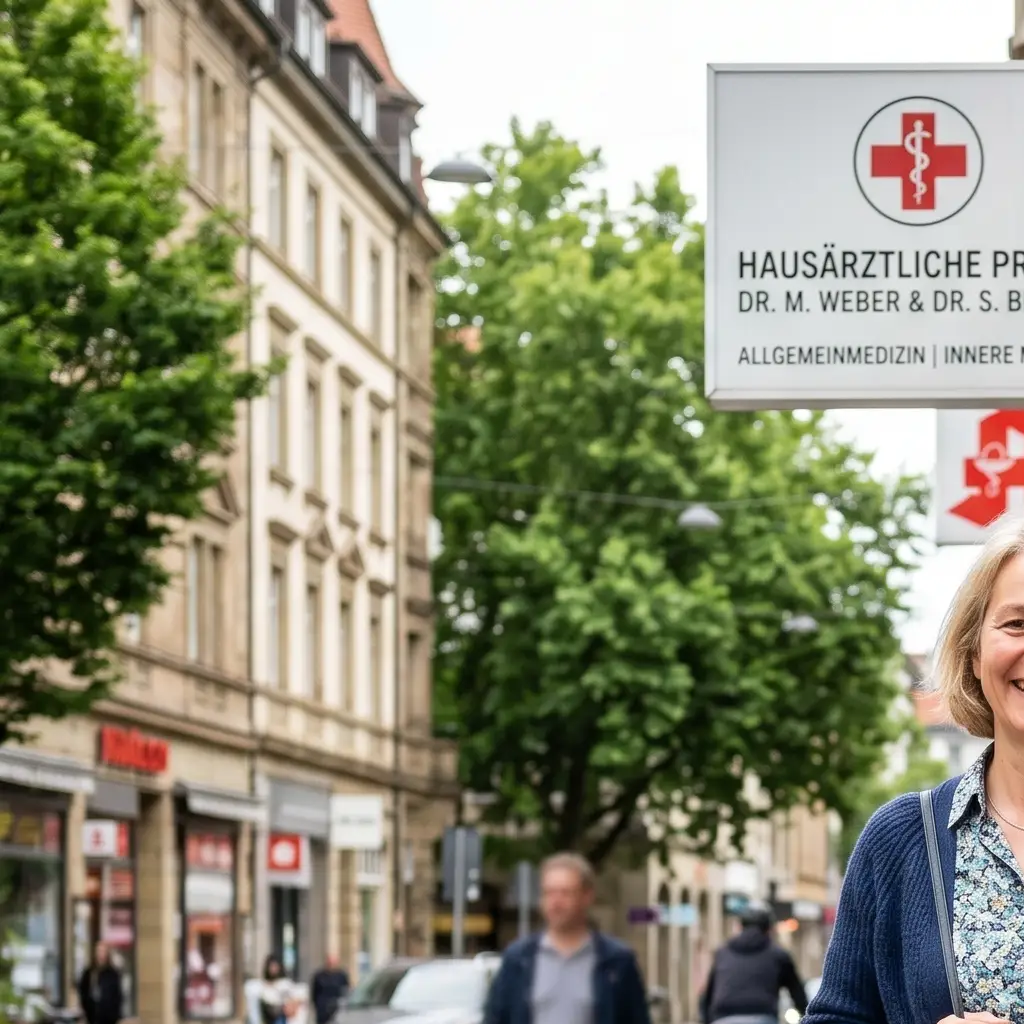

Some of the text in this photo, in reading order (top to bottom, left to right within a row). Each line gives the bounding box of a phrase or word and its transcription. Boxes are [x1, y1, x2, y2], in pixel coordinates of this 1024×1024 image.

[738, 243, 982, 280] HAUSÄRZTLICHE
[738, 290, 776, 313] DR.
[785, 290, 811, 313] M.
[819, 290, 900, 313] WEBER
[909, 290, 925, 313] &
[933, 289, 971, 313] DR.
[979, 289, 999, 313] S.
[738, 345, 926, 365] ALLGEMEINMEDIZIN
[944, 345, 1013, 364] INNERE
